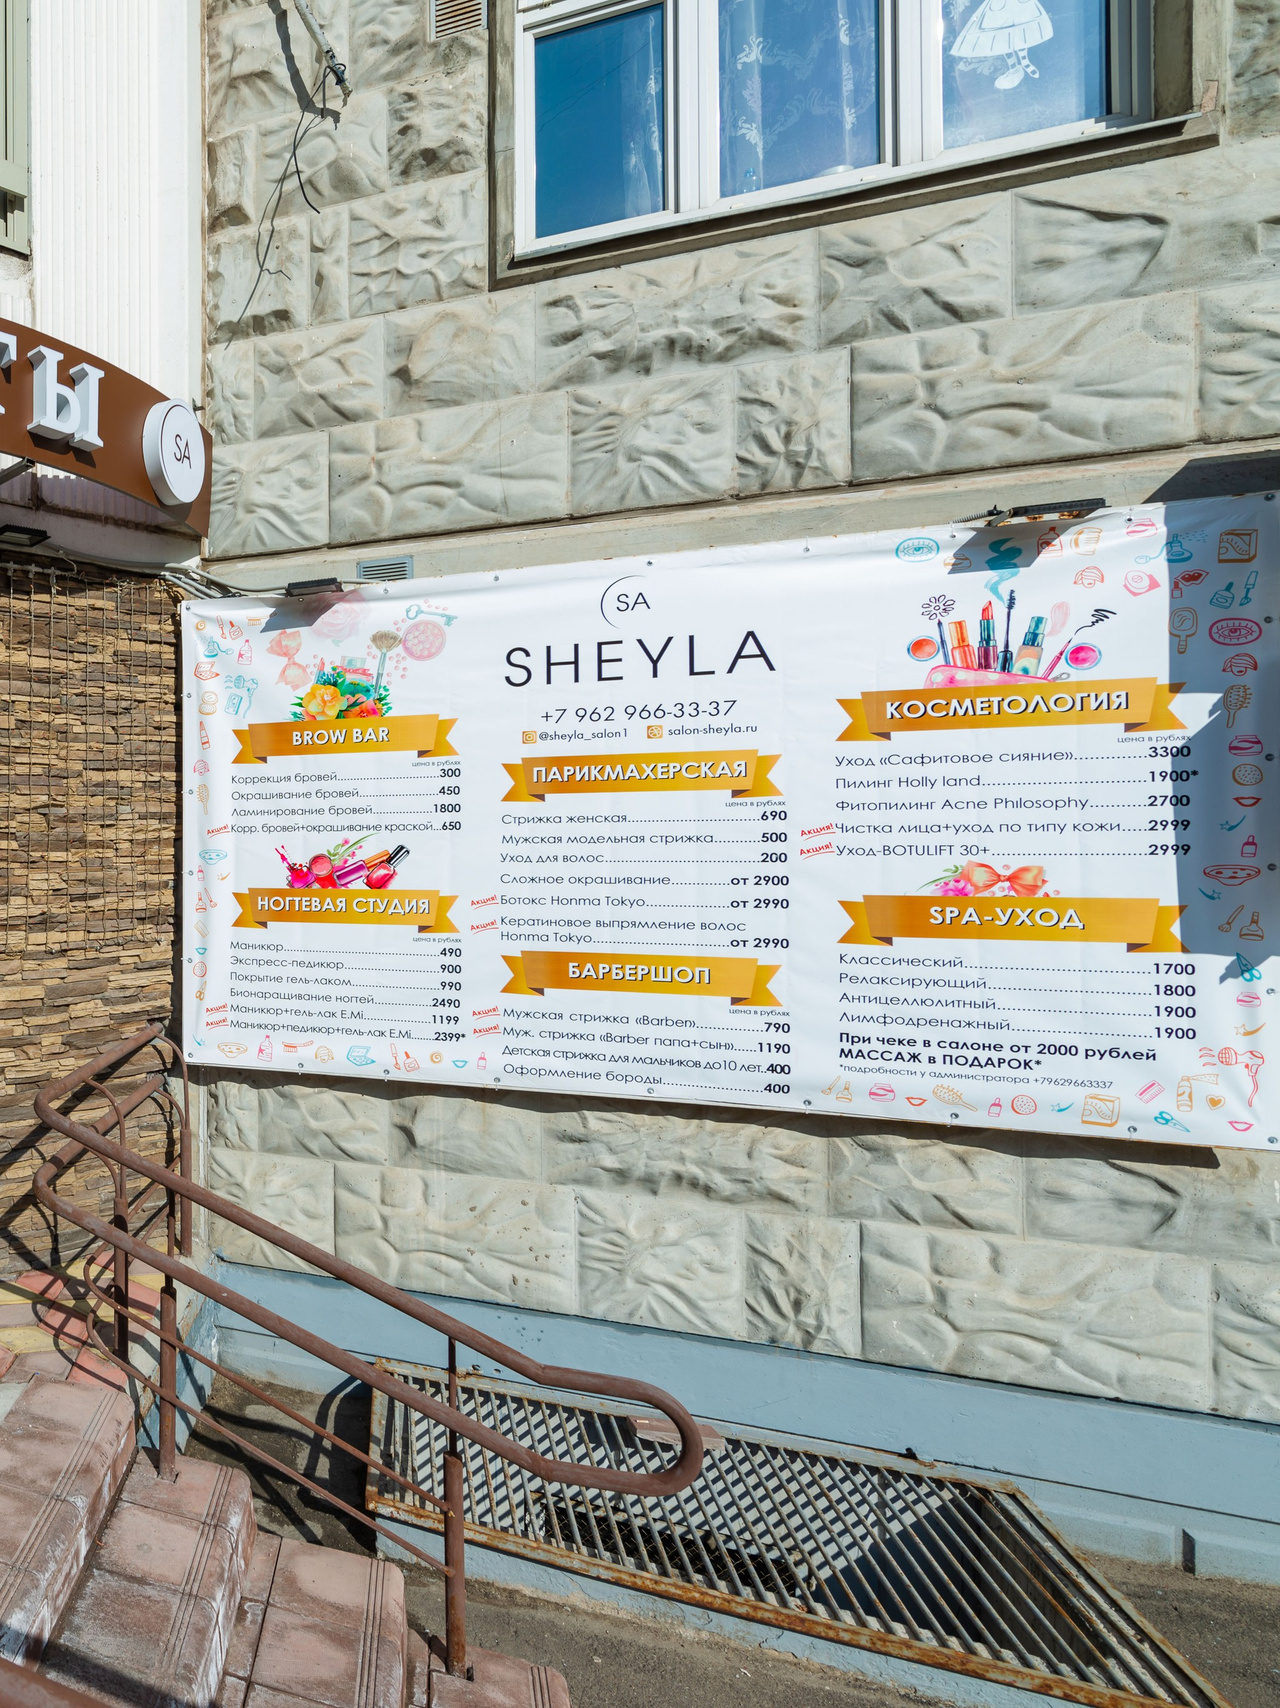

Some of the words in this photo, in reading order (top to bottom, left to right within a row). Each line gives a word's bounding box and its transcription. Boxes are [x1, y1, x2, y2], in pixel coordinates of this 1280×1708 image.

[174, 434, 191, 469] SA
[616, 592, 650, 611] SA
[504, 630, 776, 687] SHEYLA
[541, 708, 567, 724] +7
[575, 706, 615, 722] 962
[624, 700, 737, 720] 966-33-37
[886, 691, 1129, 720] КОСМЕТОЛОГИЯ
[292, 729, 347, 746] BROW
[352, 727, 390, 743] BAR
[668, 724, 758, 737] salon-sheyla.ru
[1117, 735, 1145, 743] цена
[1156, 734, 1191, 744] рублях
[835, 755, 875, 767] Уход
[880, 753, 993, 767] «Сафитовое
[999, 751, 1073, 762] сияние»
[1149, 746, 1191, 758] 3300
[231, 774, 292, 785] Коррекция
[295, 772, 337, 783] бровей
[440, 769, 461, 778] 300
[533, 761, 747, 783] ПАРИКМАХЕРСКАЯ
[835, 778, 893, 789] Пилинг
[899, 776, 937, 790] Holly
[943, 775, 981, 786] land
[231, 790, 312, 801] Окрашивание
[315, 788, 359, 799] бровей
[439, 786, 460, 795] 450
[835, 800, 936, 811] Фитопилинг
[942, 799, 987, 809] Acne
[994, 797, 1088, 811] Philosophy
[1148, 795, 1191, 807] 2700
[231, 807, 325, 818] Ламинирование
[328, 805, 372, 816] бровей
[434, 804, 461, 813] 1800
[502, 814, 561, 825] Стрижка
[566, 813, 627, 824] женская
[761, 810, 787, 821] 690
[207, 824, 229, 836] Акция!
[231, 824, 259, 833] Корр.
[261, 823, 382, 834] бровей+окрашивание
[385, 821, 432, 833] краской
[441, 822, 461, 830] 650
[800, 823, 833, 837] Акция!
[835, 823, 892, 834] Чистка
[898, 823, 994, 835] лица+уход
[1000, 824, 1021, 832] по
[1027, 823, 1067, 835] типу
[1073, 822, 1120, 832] кожи
[1148, 819, 1191, 831] 2999
[502, 834, 562, 846] Мужская
[567, 834, 644, 844] модельная
[650, 833, 714, 845] стрижка
[761, 832, 787, 843] 500
[500, 853, 532, 864] Уход
[536, 854, 558, 864] для
[562, 854, 604, 863] волос
[761, 853, 787, 863] 200
[800, 842, 832, 856] Акция!
[836, 844, 954, 857] Уход-BOTULIFT
[960, 845, 990, 856] 30+
[1148, 844, 1191, 856] 2999
[500, 874, 564, 885] Сложное
[569, 875, 670, 887] окрашивание
[731, 876, 749, 886] от
[754, 875, 789, 886] 2900
[257, 896, 347, 913] НОГТЕВАЯ
[352, 897, 430, 914] СТУДИЯ
[470, 894, 497, 907] Акция!
[500, 895, 547, 906] Ботокс
[551, 895, 600, 907] Honma
[605, 896, 645, 909] Tokyo
[731, 900, 748, 909] от
[753, 898, 789, 909] 2990
[470, 920, 497, 931] Акция!
[500, 917, 591, 928] Кератиновое
[595, 919, 695, 932] выпрямление
[700, 920, 746, 932] волос
[929, 906, 1085, 930] SPA-УХОД
[230, 941, 283, 952] Маникюр
[440, 948, 461, 957] 490
[500, 932, 549, 942] Honma
[553, 933, 592, 945] Tokyo
[730, 940, 748, 948] от
[753, 938, 789, 949] 2990
[230, 956, 344, 971] Экспресс-педикюр
[440, 965, 461, 973] 900
[568, 962, 711, 984] БАРБЕРШОП
[839, 954, 963, 968] Классический
[1154, 963, 1195, 975] 1700
[230, 972, 283, 984] Покрытие
[286, 976, 351, 986] гель-лаком
[440, 982, 461, 991] 990
[839, 973, 986, 989] Релаксирующий
[1154, 984, 1195, 997] 1800
[230, 989, 332, 1003] Бионаращивание
[336, 994, 374, 1005] ногтей
[432, 999, 460, 1008] 2490
[839, 993, 996, 1010] Антицеллюлитный
[1154, 1006, 1196, 1018] 1900
[206, 1003, 227, 1013] Акция!
[230, 1004, 337, 1019] Маникюр+гель-лак
[431, 1015, 459, 1025] 1199
[472, 1007, 498, 1017] Акция!
[503, 1009, 563, 1021] Мужская
[570, 1013, 629, 1026] стрижка
[764, 1022, 790, 1034] 790
[206, 1017, 227, 1028] Акция!
[230, 1020, 386, 1038] Маникюр+педикюр+гель-лак
[839, 1012, 1010, 1031] Лимфодренажный
[1154, 1027, 1196, 1040] 1900
[473, 1024, 499, 1035] Акция!
[503, 1027, 534, 1039] Муж.
[539, 1029, 595, 1043] стрижка
[599, 1032, 649, 1046] «Barber
[654, 1037, 735, 1051] папа+сын»
[757, 1042, 790, 1054] 1190
[839, 1033, 871, 1045] При
[877, 1036, 917, 1046] чеке
[923, 1040, 931, 1048] в
[938, 1040, 1003, 1052] салоне
[1010, 1044, 1031, 1054] от
[1037, 1044, 1078, 1056] 2000
[1085, 1047, 1156, 1061] рублей
[502, 1046, 550, 1058] Детская
[553, 1049, 606, 1062] стрижка
[609, 1053, 629, 1063] для
[631, 1055, 701, 1069] мальчиков
[739, 1062, 761, 1073] лет
[766, 1063, 790, 1075] 400
[839, 1049, 921, 1063] МАССАЖ
[928, 1056, 936, 1064] в
[504, 1064, 601, 1081] Оформление
[606, 1071, 662, 1086] бороды
[764, 1084, 790, 1094] 400
[920, 1070, 925, 1078] у
[930, 1071, 1029, 1084] администратора
[1033, 1077, 1113, 1089] +79629663337
